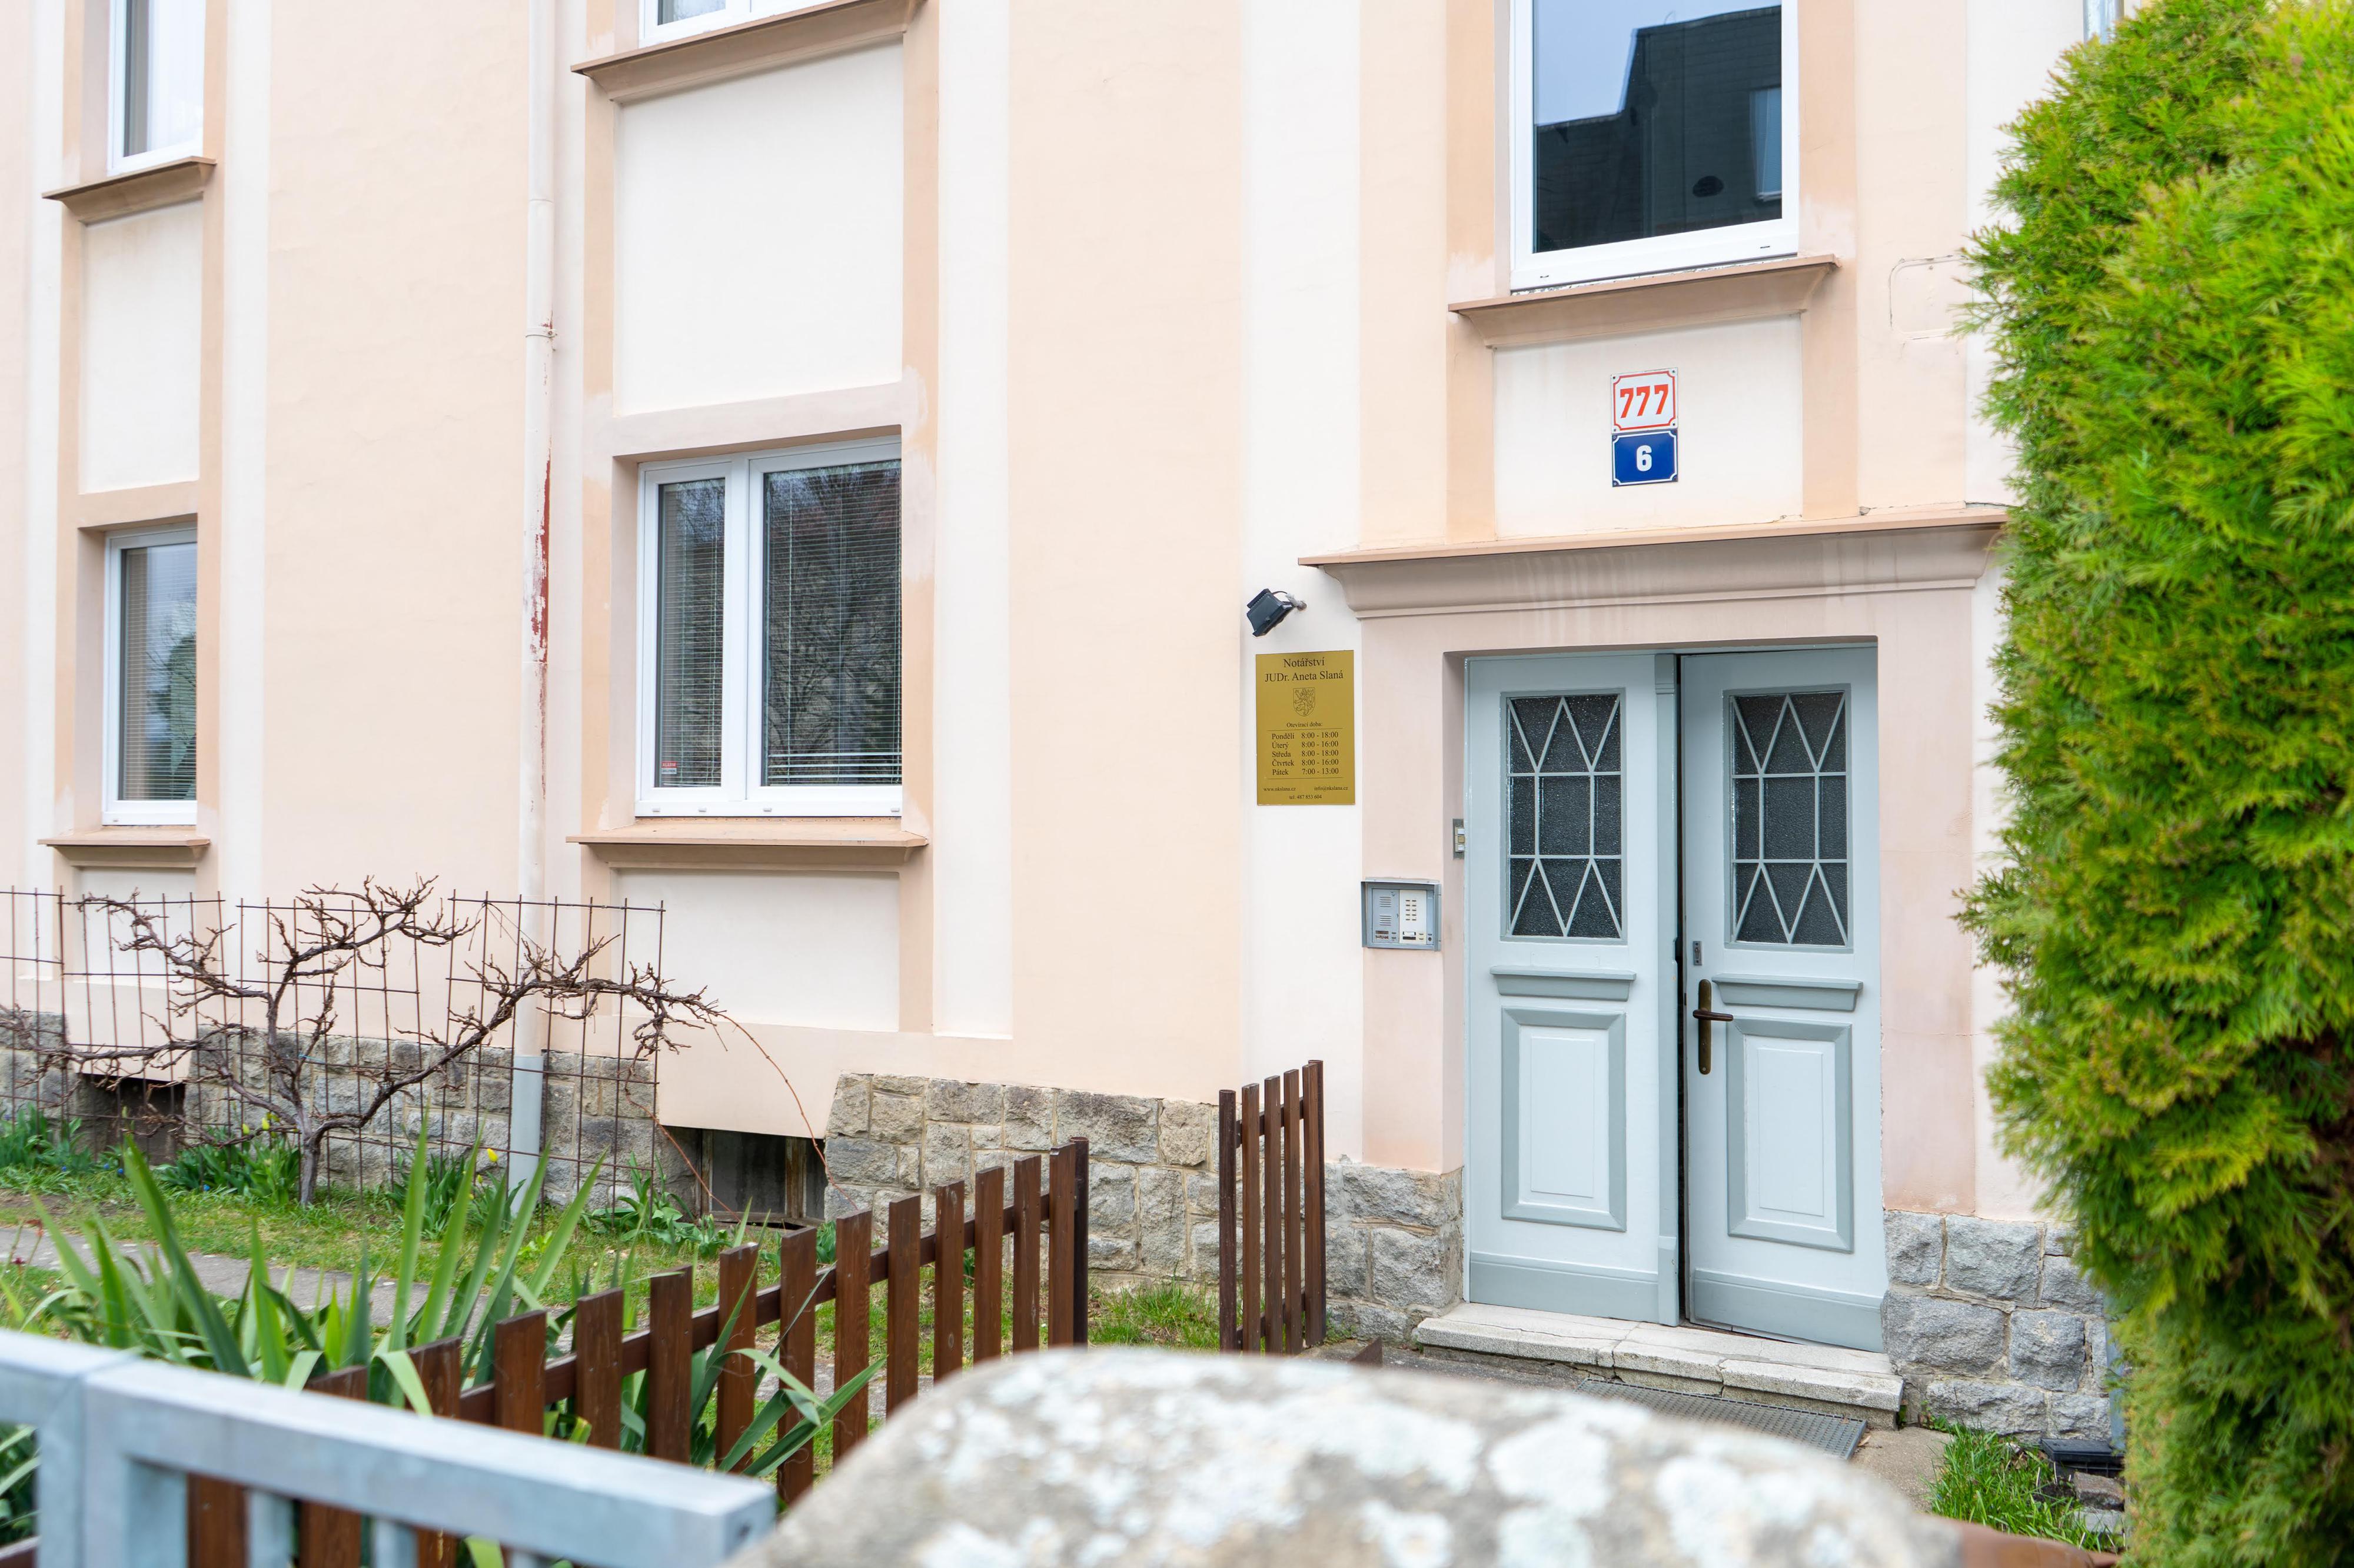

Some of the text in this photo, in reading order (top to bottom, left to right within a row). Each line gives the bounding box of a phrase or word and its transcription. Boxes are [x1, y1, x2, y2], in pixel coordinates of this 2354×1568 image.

[1620, 384, 1668, 418] 777
[1636, 445, 1653, 472] 6
[1284, 657, 1324, 668] Notářství
[1265, 670, 1344, 683] JUDr. Aneta Slaná
[1272, 740, 1289, 750] Úterý
[1272, 758, 1295, 767] Čtvrtek
